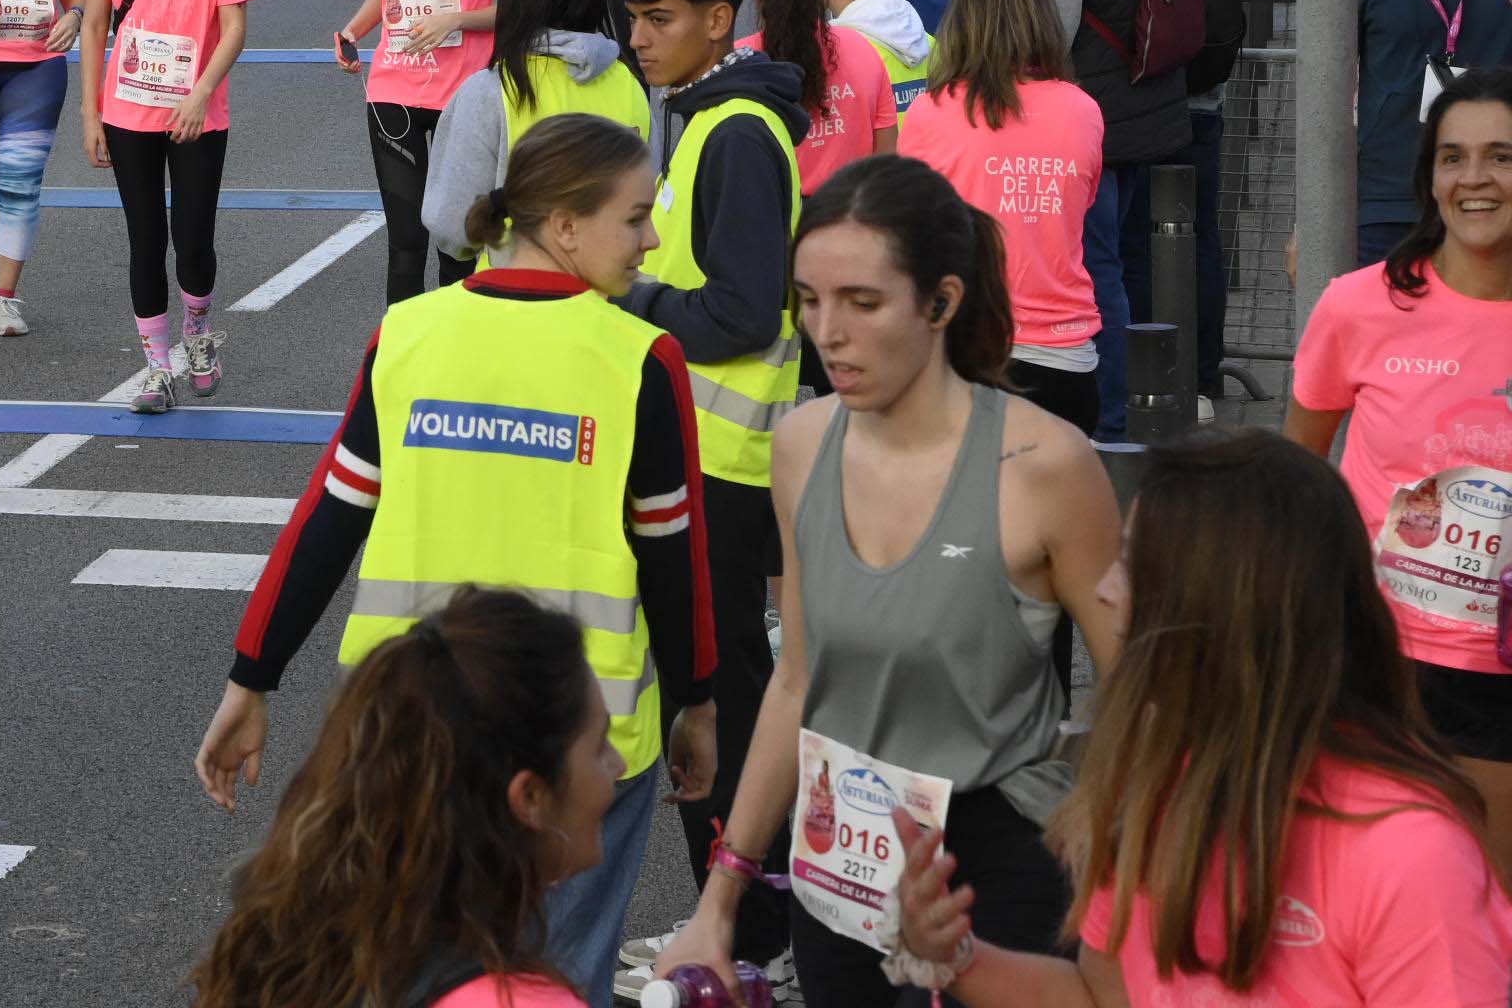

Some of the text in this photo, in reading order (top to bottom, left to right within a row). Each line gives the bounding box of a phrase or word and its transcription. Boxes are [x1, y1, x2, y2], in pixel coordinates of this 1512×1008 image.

[4, 6, 29, 15] 016
[404, 5, 432, 16] 016
[141, 61, 167, 74] 016
[142, 74, 162, 83] 22406
[807, 119, 845, 139] UJER
[985, 157, 1078, 177] CARRERA
[1003, 176, 1060, 195] DE LA
[998, 195, 1062, 215] MUJER
[1385, 357, 1460, 377] OYSHO
[409, 412, 572, 450] VOLUNTARIS
[581, 418, 593, 463] 2000
[1444, 523, 1502, 556] 016
[1394, 559, 1472, 588] CARRERA DE LA
[1455, 555, 1481, 573] 123
[839, 823, 890, 861] 016
[843, 860, 877, 883] 2217
